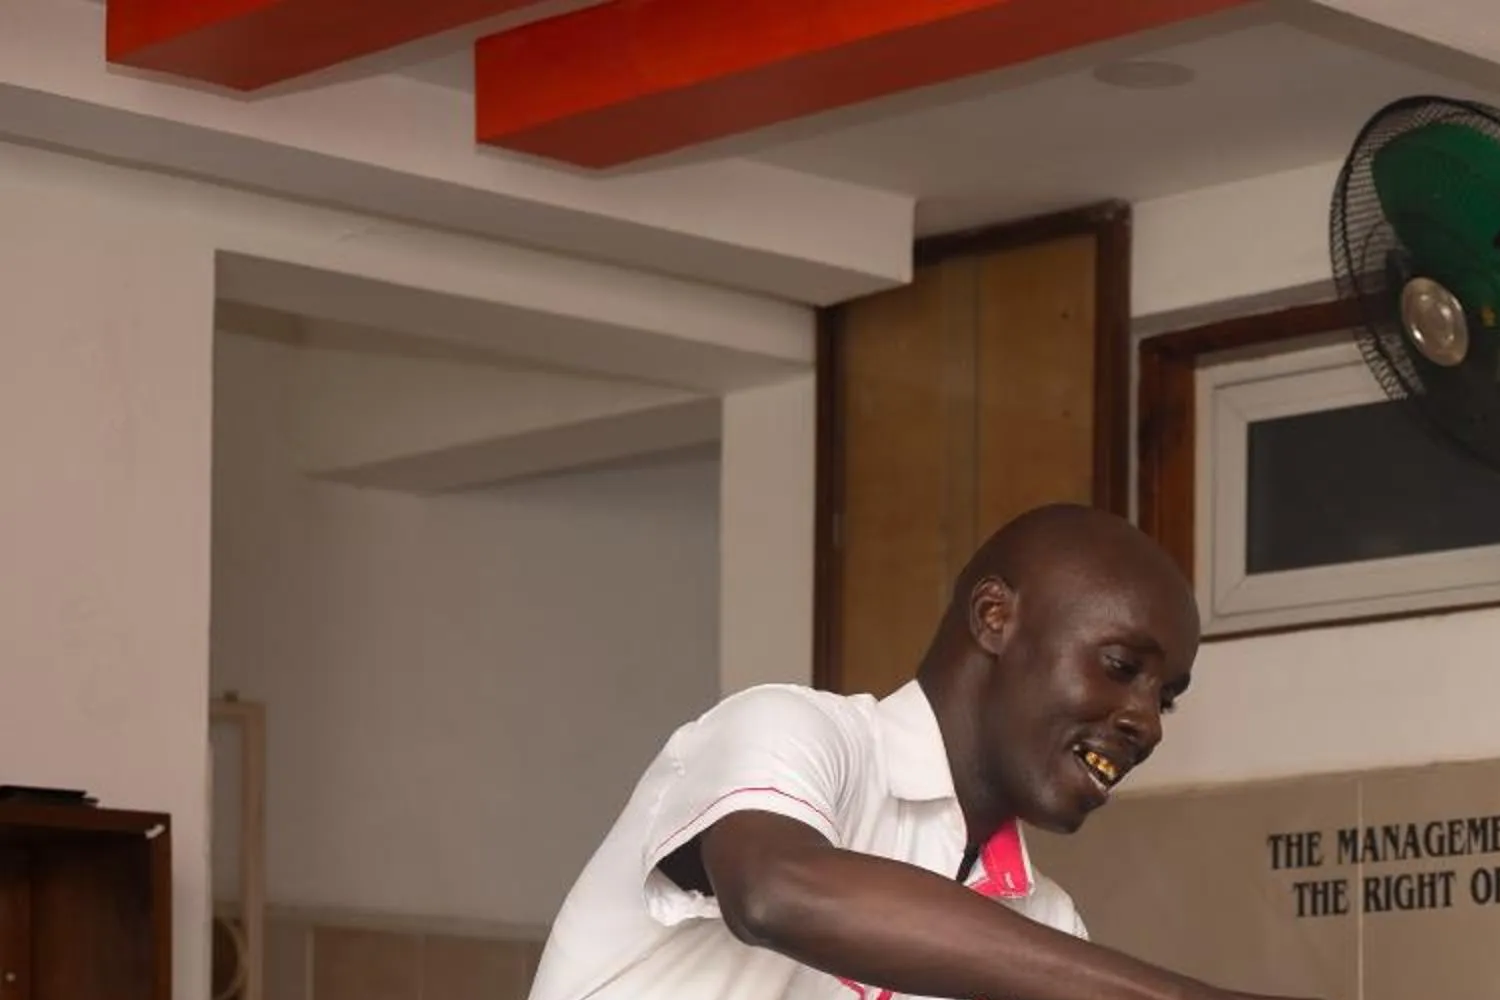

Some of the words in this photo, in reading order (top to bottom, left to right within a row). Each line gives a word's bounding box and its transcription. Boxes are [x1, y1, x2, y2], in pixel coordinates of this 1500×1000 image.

[1267, 831, 1324, 870] THE
[1293, 878, 1349, 917] THE
[1362, 870, 1457, 915] RIGHT
